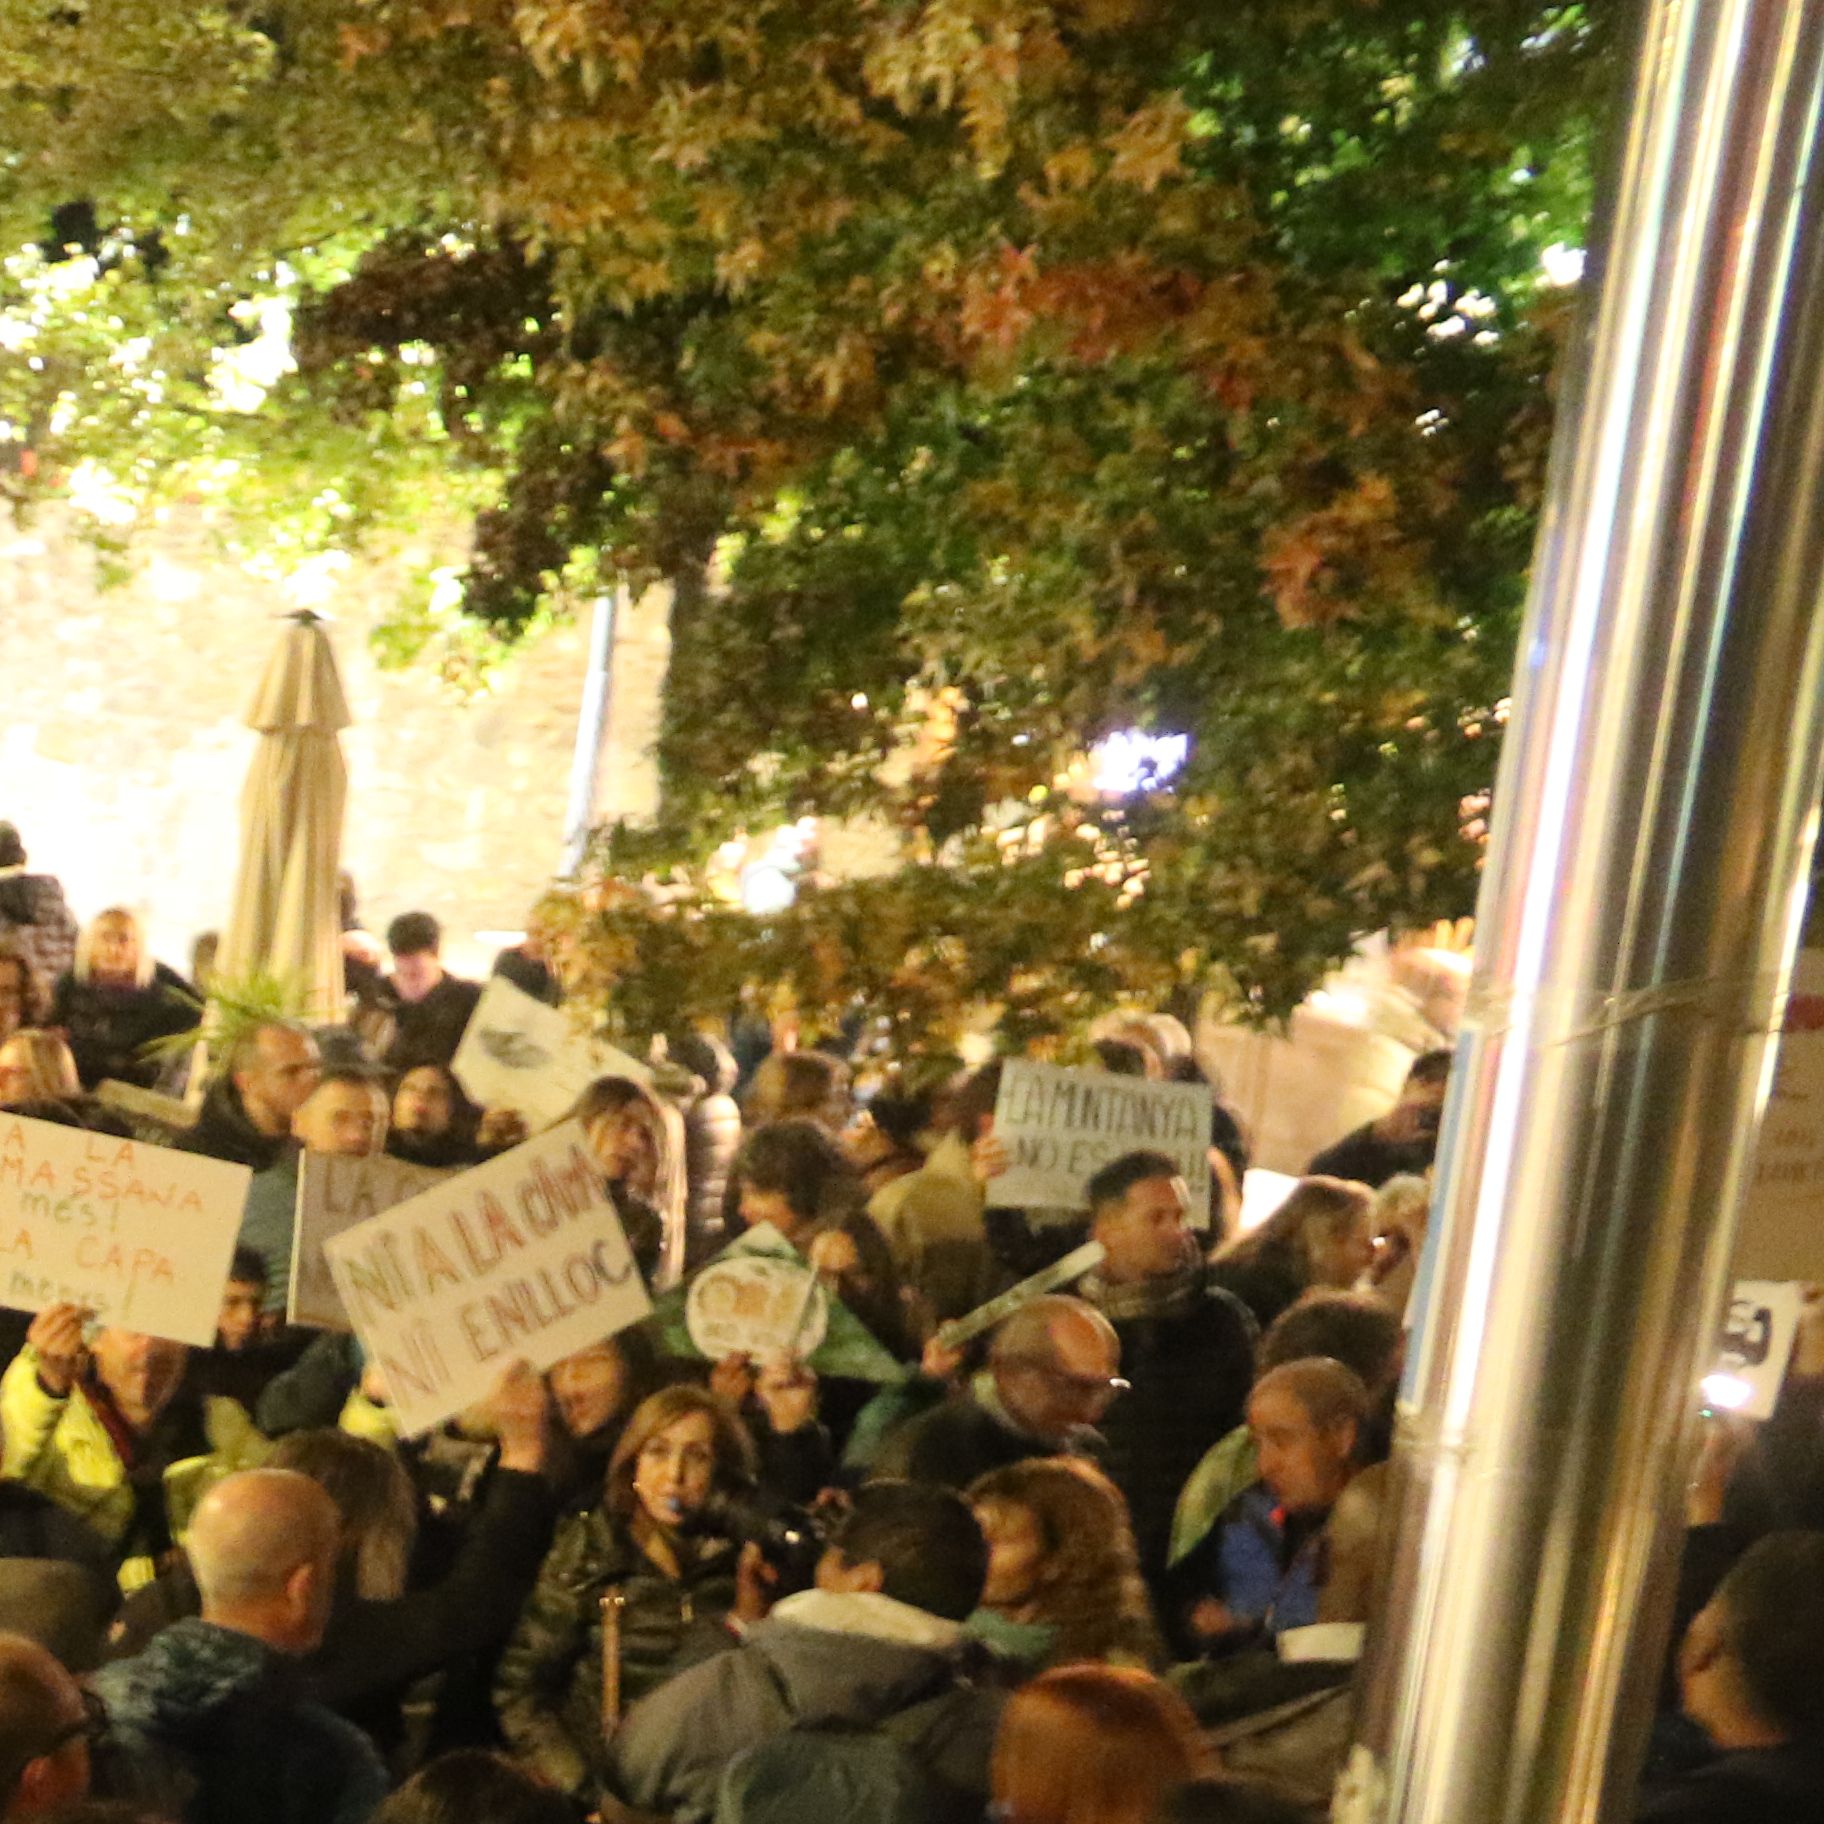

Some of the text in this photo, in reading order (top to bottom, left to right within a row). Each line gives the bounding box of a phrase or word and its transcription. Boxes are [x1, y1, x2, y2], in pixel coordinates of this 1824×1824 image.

[3, 1120, 136, 1169] A LA
[0, 1152, 203, 1213] MASSANA
[74, 1234, 175, 1286] CAPA
[410, 1224, 462, 1297] A
[448, 1188, 527, 1278] LA
